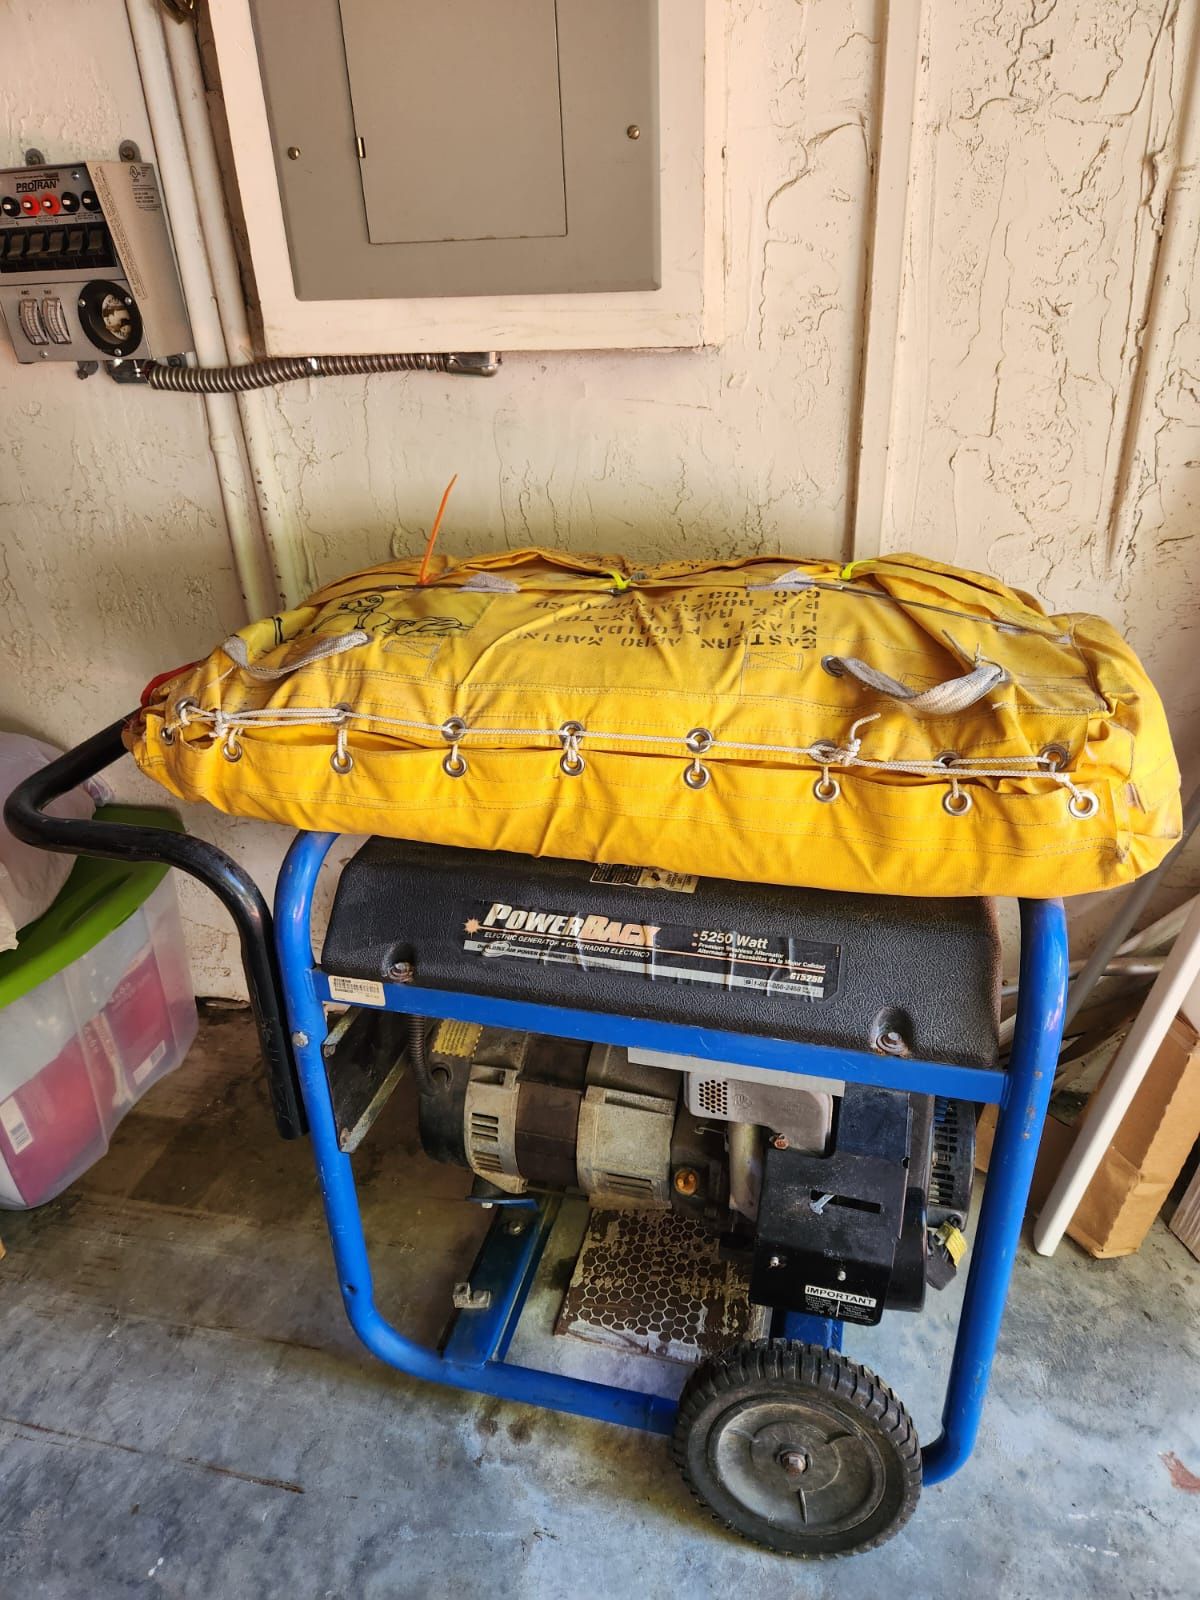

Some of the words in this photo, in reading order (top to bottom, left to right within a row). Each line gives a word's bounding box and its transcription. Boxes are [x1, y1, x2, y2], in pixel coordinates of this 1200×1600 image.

[16, 179, 58, 193] PROTRAN
[672, 607, 735, 622] RAFT
[752, 607, 818, 622] LIFE
[593, 623, 701, 636] FLORIDA
[517, 631, 601, 646] MARIN
[620, 635, 681, 648] AERO
[701, 633, 817, 649] EASTERN
[484, 931, 518, 942] ELECTRIC
[518, 935, 560, 947] GENERATOR
[565, 940, 609, 953] GENERADOR
[699, 930, 733, 944] 5250
[736, 933, 769, 950] Watt
[698, 942, 724, 952] Premium
[754, 949, 784, 959] Alternator
[802, 960, 826, 970] Calidad
[789, 971, 825, 984] GT5250
[806, 1286, 873, 1305] IMPORTANT
